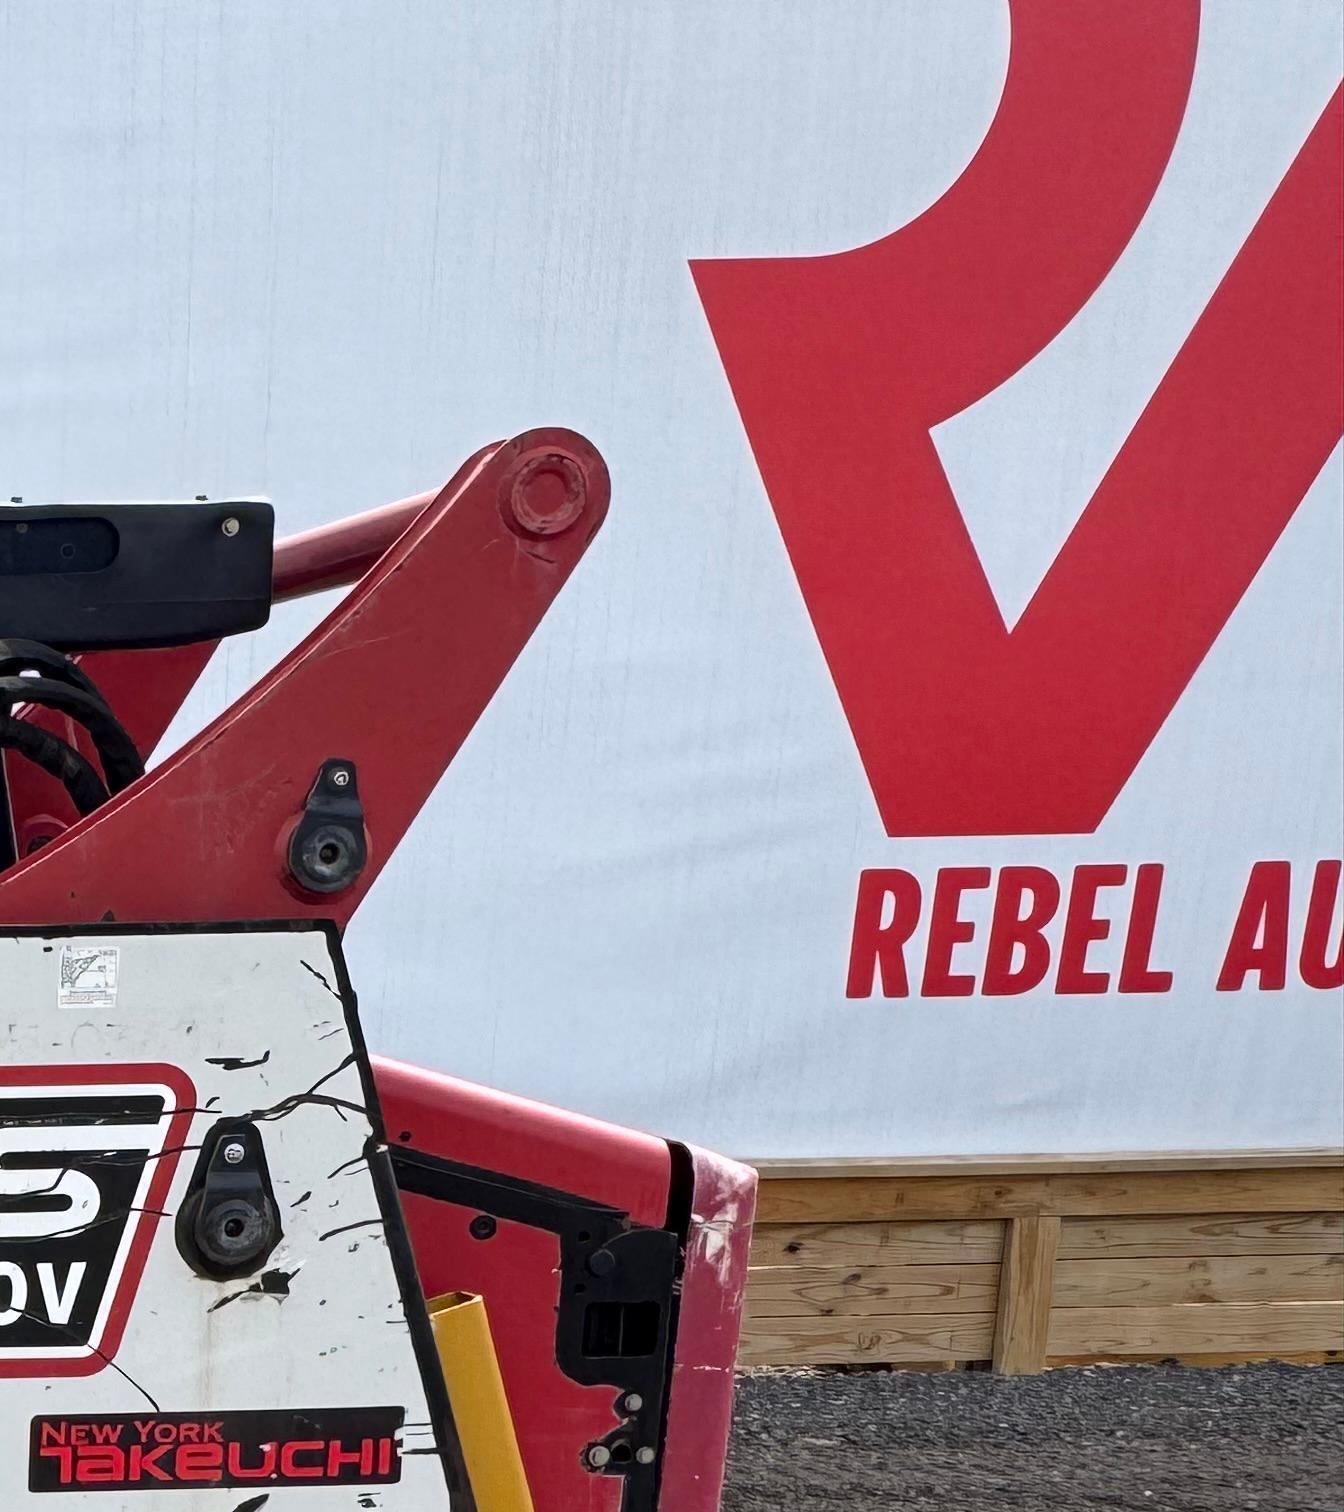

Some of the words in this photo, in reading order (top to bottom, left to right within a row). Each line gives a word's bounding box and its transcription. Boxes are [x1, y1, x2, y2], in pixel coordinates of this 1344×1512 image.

[845, 863, 1174, 999] REBEL
[40, 1420, 124, 1446] NEW
[132, 1419, 225, 1444] YORK
